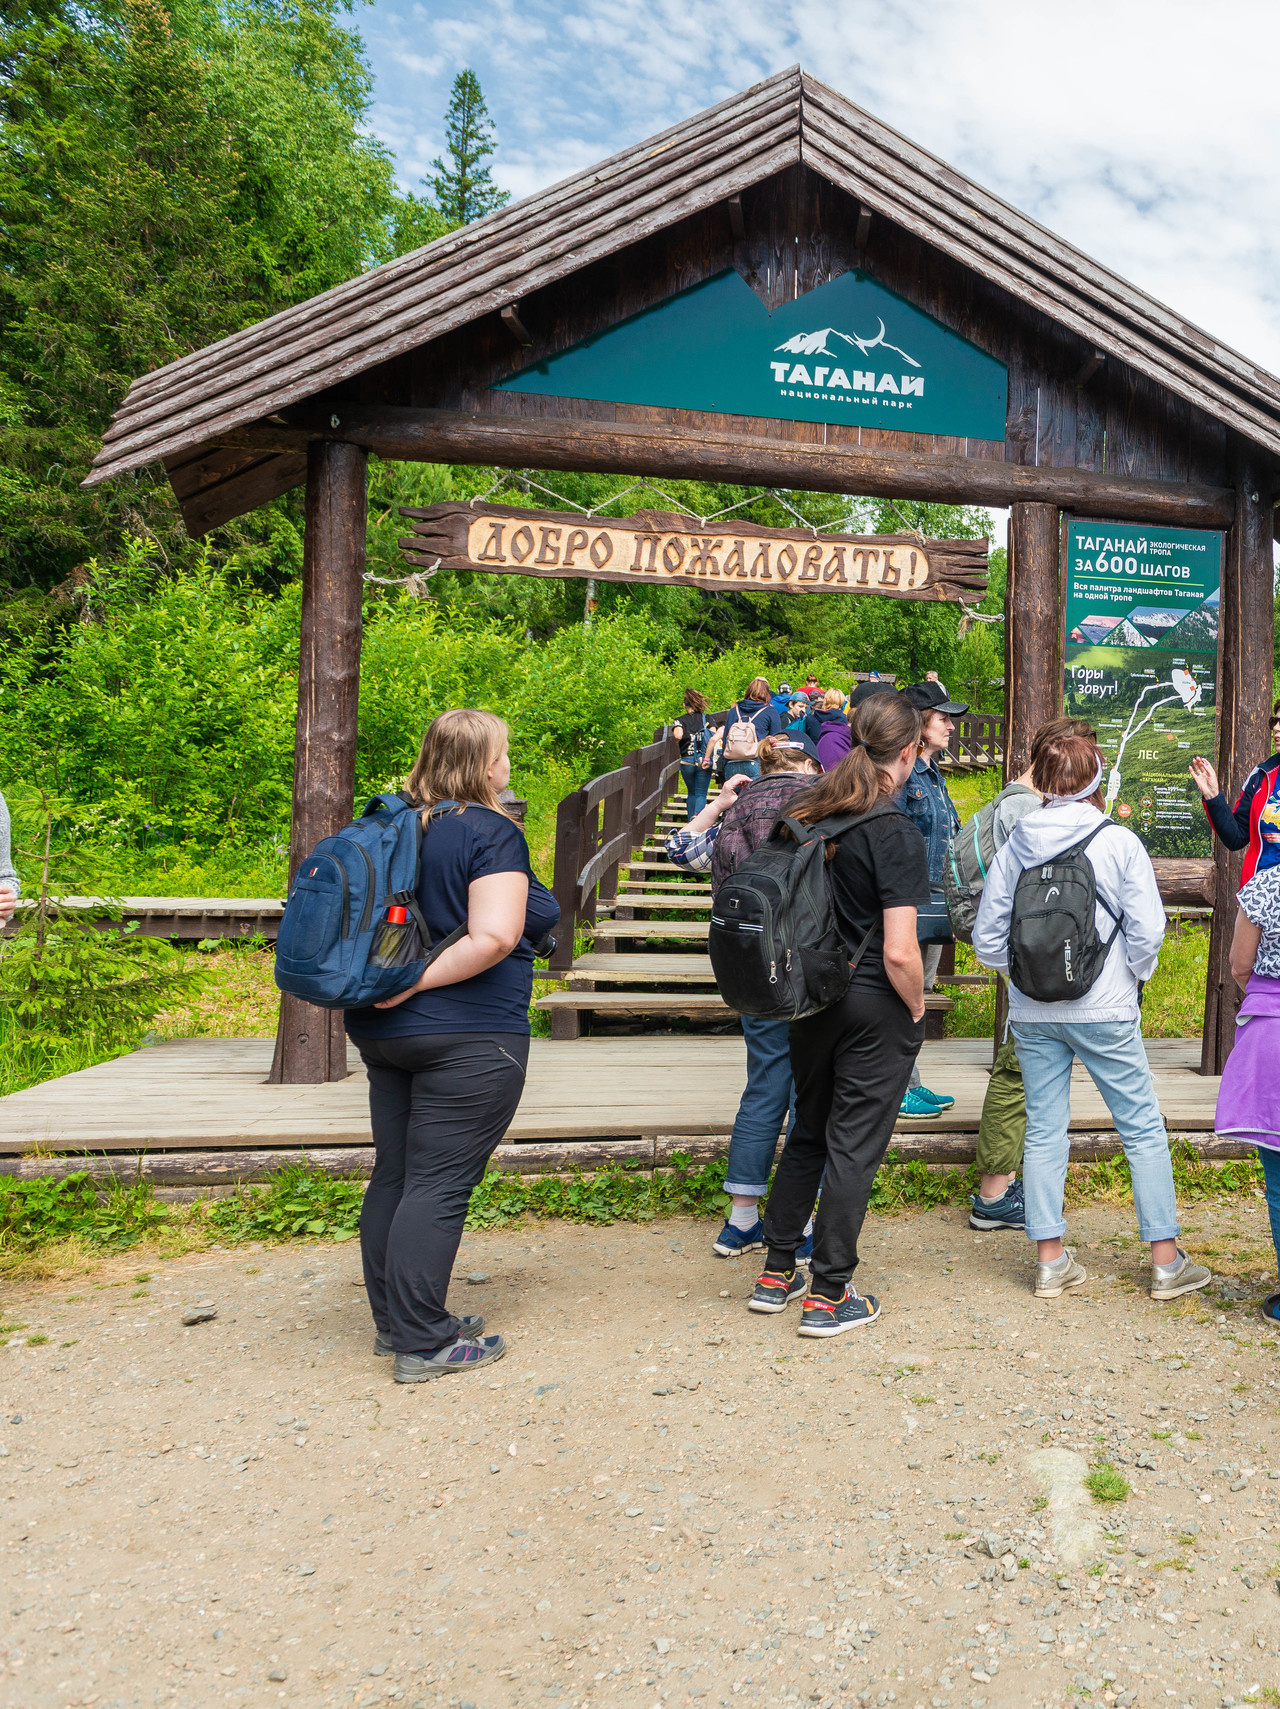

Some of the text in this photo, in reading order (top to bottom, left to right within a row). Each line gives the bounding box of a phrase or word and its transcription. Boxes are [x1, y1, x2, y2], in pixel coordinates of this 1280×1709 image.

[770, 361, 925, 396] ТАГАНАЙ
[780, 388, 913, 409] национальный парк
[477, 522, 918, 586] ДОБРО ПОЖАЛОВАТЬ!
[1075, 535, 1206, 554] ТАГАНАЙ ЭКОЛОГИЧЕСКАЯ
[1074, 552, 1191, 578] ЗА 600 ШАГОВ
[1073, 582, 1204, 598] Вся палитра ландшафтов Таганая
[1071, 665, 1104, 684] Горы
[1078, 680, 1118, 699] зовут!
[1137, 750, 1159, 760] ЛЕС
[1064, 938, 1073, 982] HEAD
